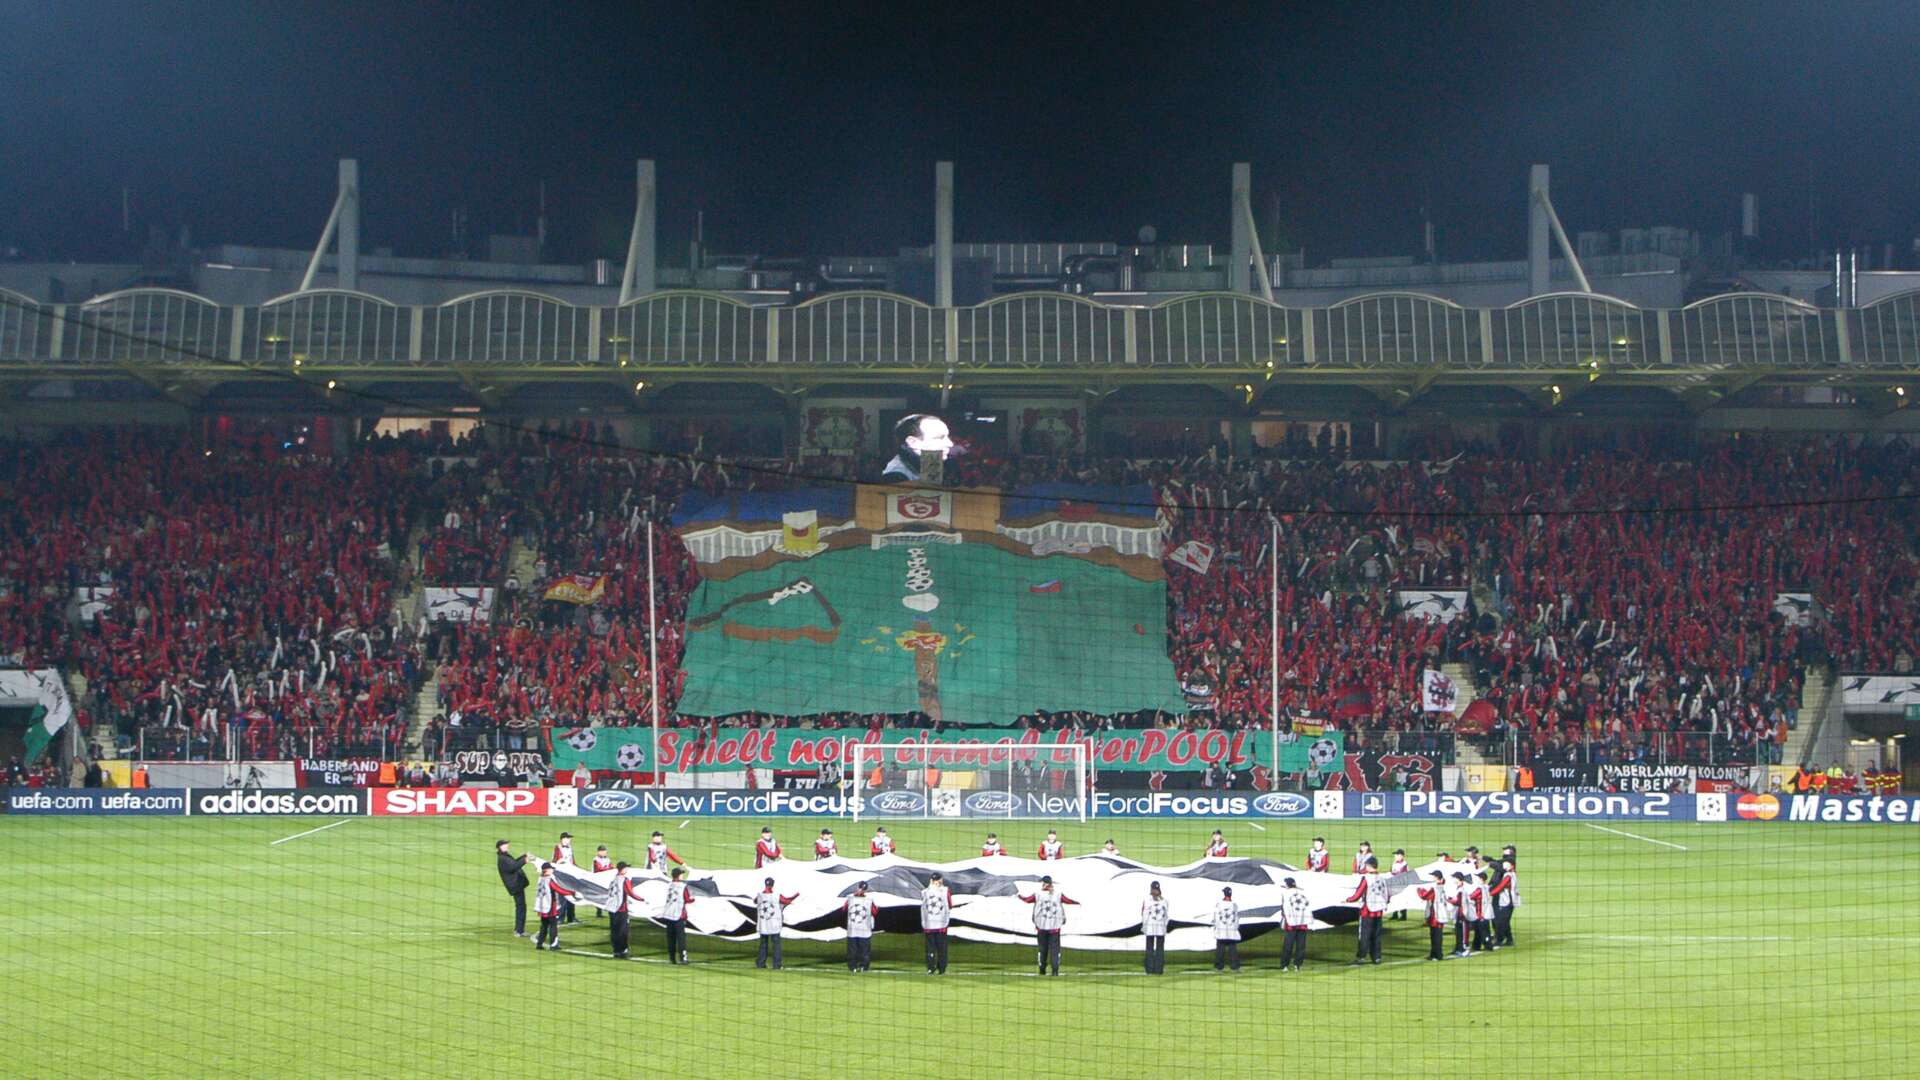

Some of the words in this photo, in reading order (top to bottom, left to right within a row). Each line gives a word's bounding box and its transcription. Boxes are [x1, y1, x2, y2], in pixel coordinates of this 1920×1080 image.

[658, 729, 777, 774] Spielt
[788, 729, 884, 765] noch
[895, 728, 1041, 767] einmal
[1549, 767, 1575, 778] 101%
[200, 790, 358, 813] adidas.com
[386, 789, 535, 813] SHARP
[592, 794, 629, 809] Ford
[643, 791, 705, 813] New
[881, 794, 918, 809] Ford
[975, 794, 1010, 810] Ford
[1027, 792, 1087, 813] New
[1264, 795, 1300, 811] Ford
